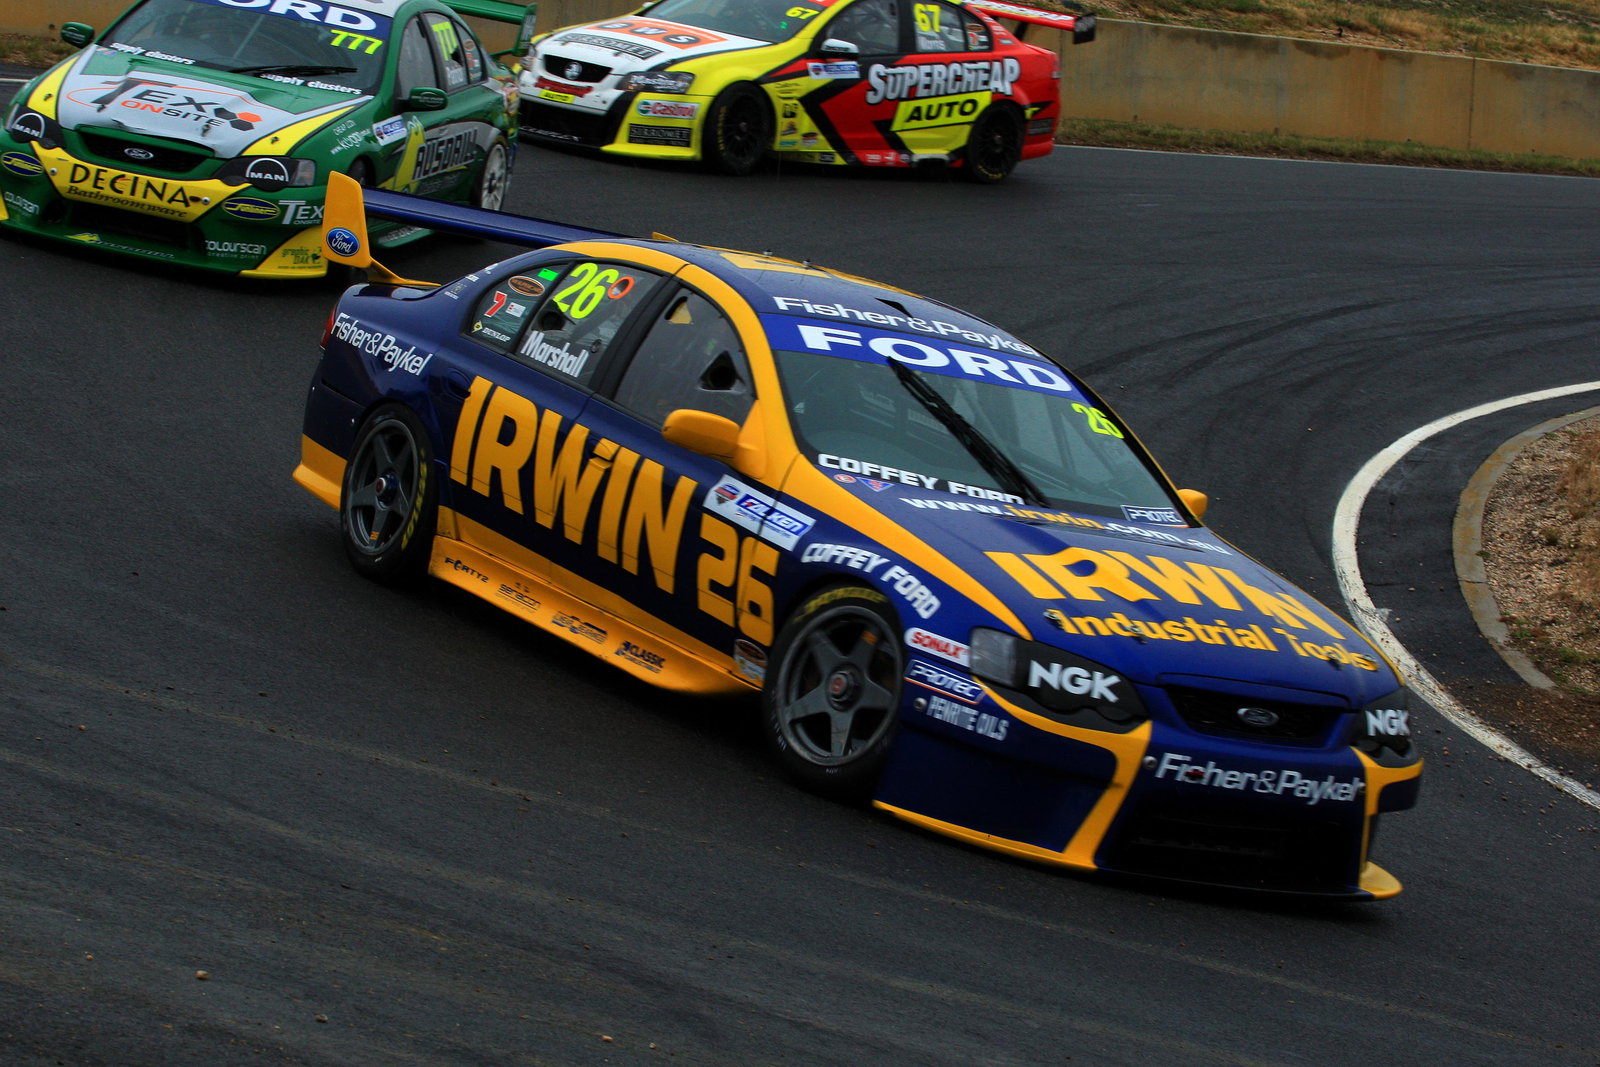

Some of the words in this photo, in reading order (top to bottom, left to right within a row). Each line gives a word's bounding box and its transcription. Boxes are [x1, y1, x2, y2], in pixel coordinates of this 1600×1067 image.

[785, 6, 820, 19] 67
[913, 3, 941, 32] 67
[109, 42, 146, 55] supply
[145, 51, 196, 65] clusters
[330, 29, 383, 55] 777
[259, 73, 305, 86] supply
[307, 80, 362, 95] clusters
[865, 56, 1020, 104] SUPERCHEAP
[121, 100, 225, 126] ONSITE
[906, 98, 977, 123] AUTO
[13, 123, 40, 137] MAN
[70, 164, 191, 207] DECINA
[250, 172, 285, 182] MAN
[66, 186, 188, 218] Bathroomware
[278, 200, 324, 224] TEX
[330, 230, 354, 254] Ford
[553, 262, 619, 319] 26
[331, 312, 433, 376] Fisher&Paykel
[520, 330, 590, 378] Marshall
[797, 324, 1072, 392] FORD
[1071, 402, 1125, 439] 26
[449, 374, 699, 596] IRWIN
[818, 453, 938, 490] COFFEY
[948, 480, 1025, 505] FORD
[899, 496, 1234, 556] www.irwin.com.au
[1126, 507, 1184, 523] PROTEC
[696, 512, 781, 648] 26
[800, 542, 891, 574] COFFEY
[880, 564, 942, 620] FORD
[983, 548, 1346, 641] IRWIN
[911, 630, 966, 660] SONAX
[1046, 608, 1279, 652] Industrial
[1273, 627, 1380, 671] Tools
[911, 664, 981, 699] PROTEC
[1027, 659, 1121, 704] NGK
[926, 695, 979, 732] PENRITE
[975, 715, 1010, 742] OILS
[1364, 709, 1411, 737] NGK
[1154, 752, 1366, 806] Fisher&Paykel
